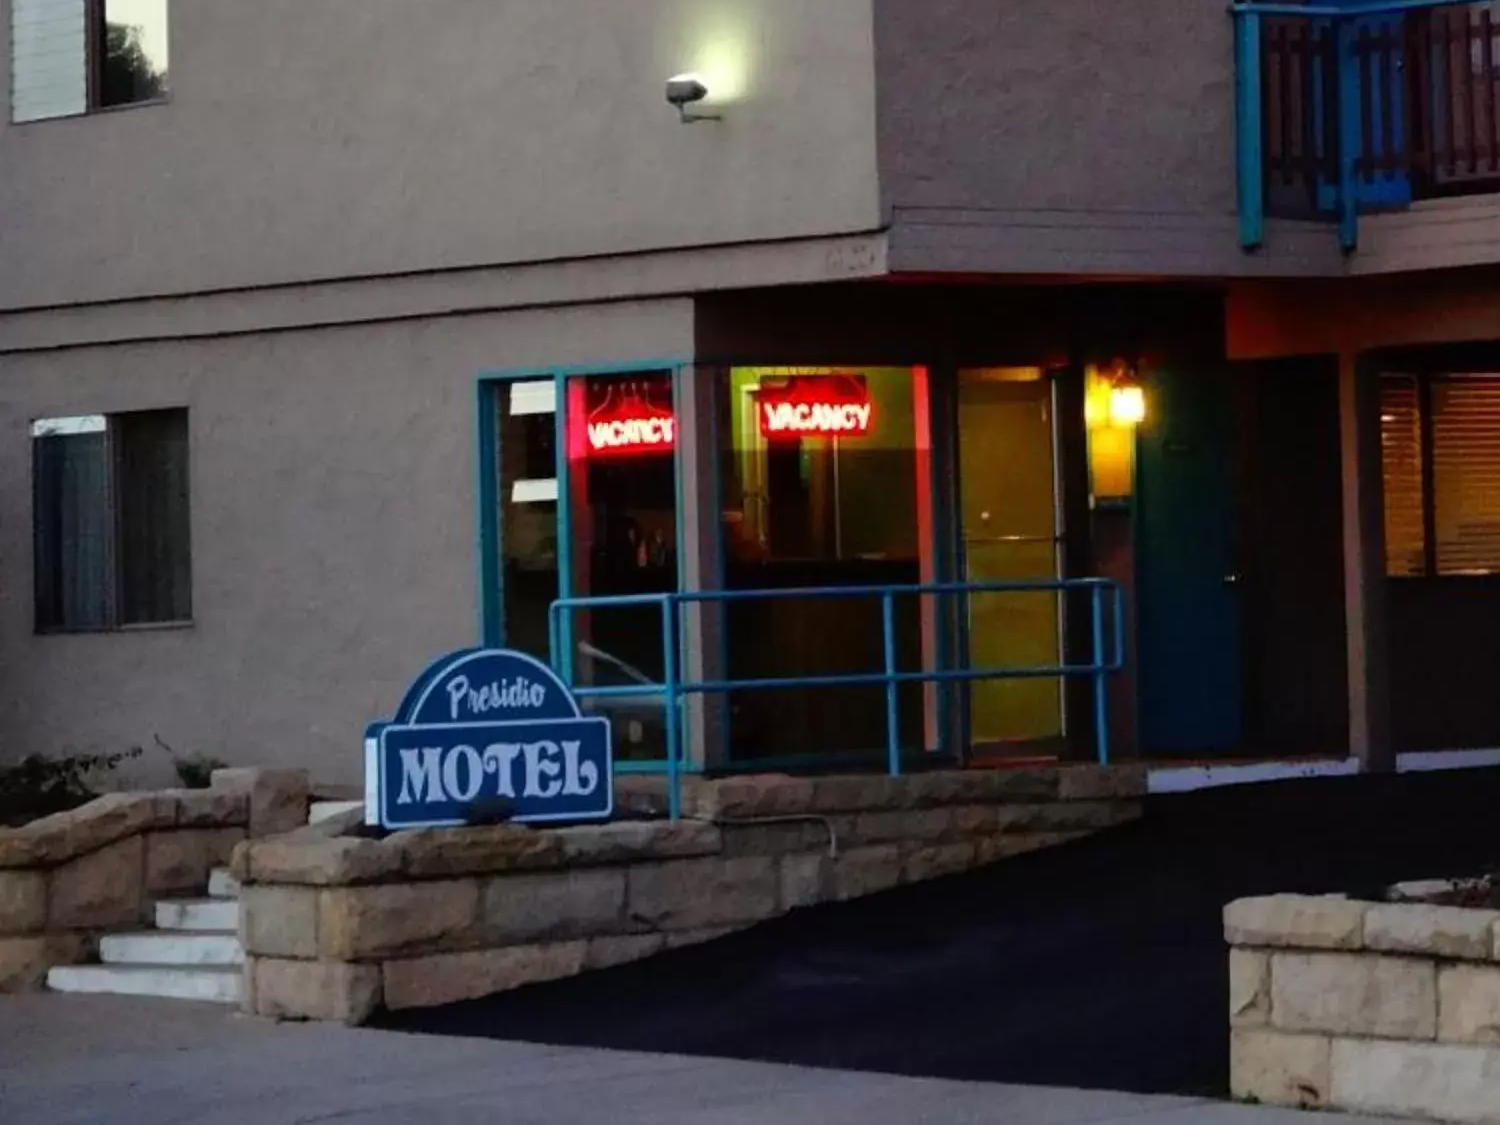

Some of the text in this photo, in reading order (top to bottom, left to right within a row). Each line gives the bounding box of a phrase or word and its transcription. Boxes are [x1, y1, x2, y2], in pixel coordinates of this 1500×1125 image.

[588, 417, 673, 449] VACANCY
[763, 402, 871, 431] VACANCY
[446, 674, 546, 719] Presidio
[397, 740, 598, 804] MOTEL
